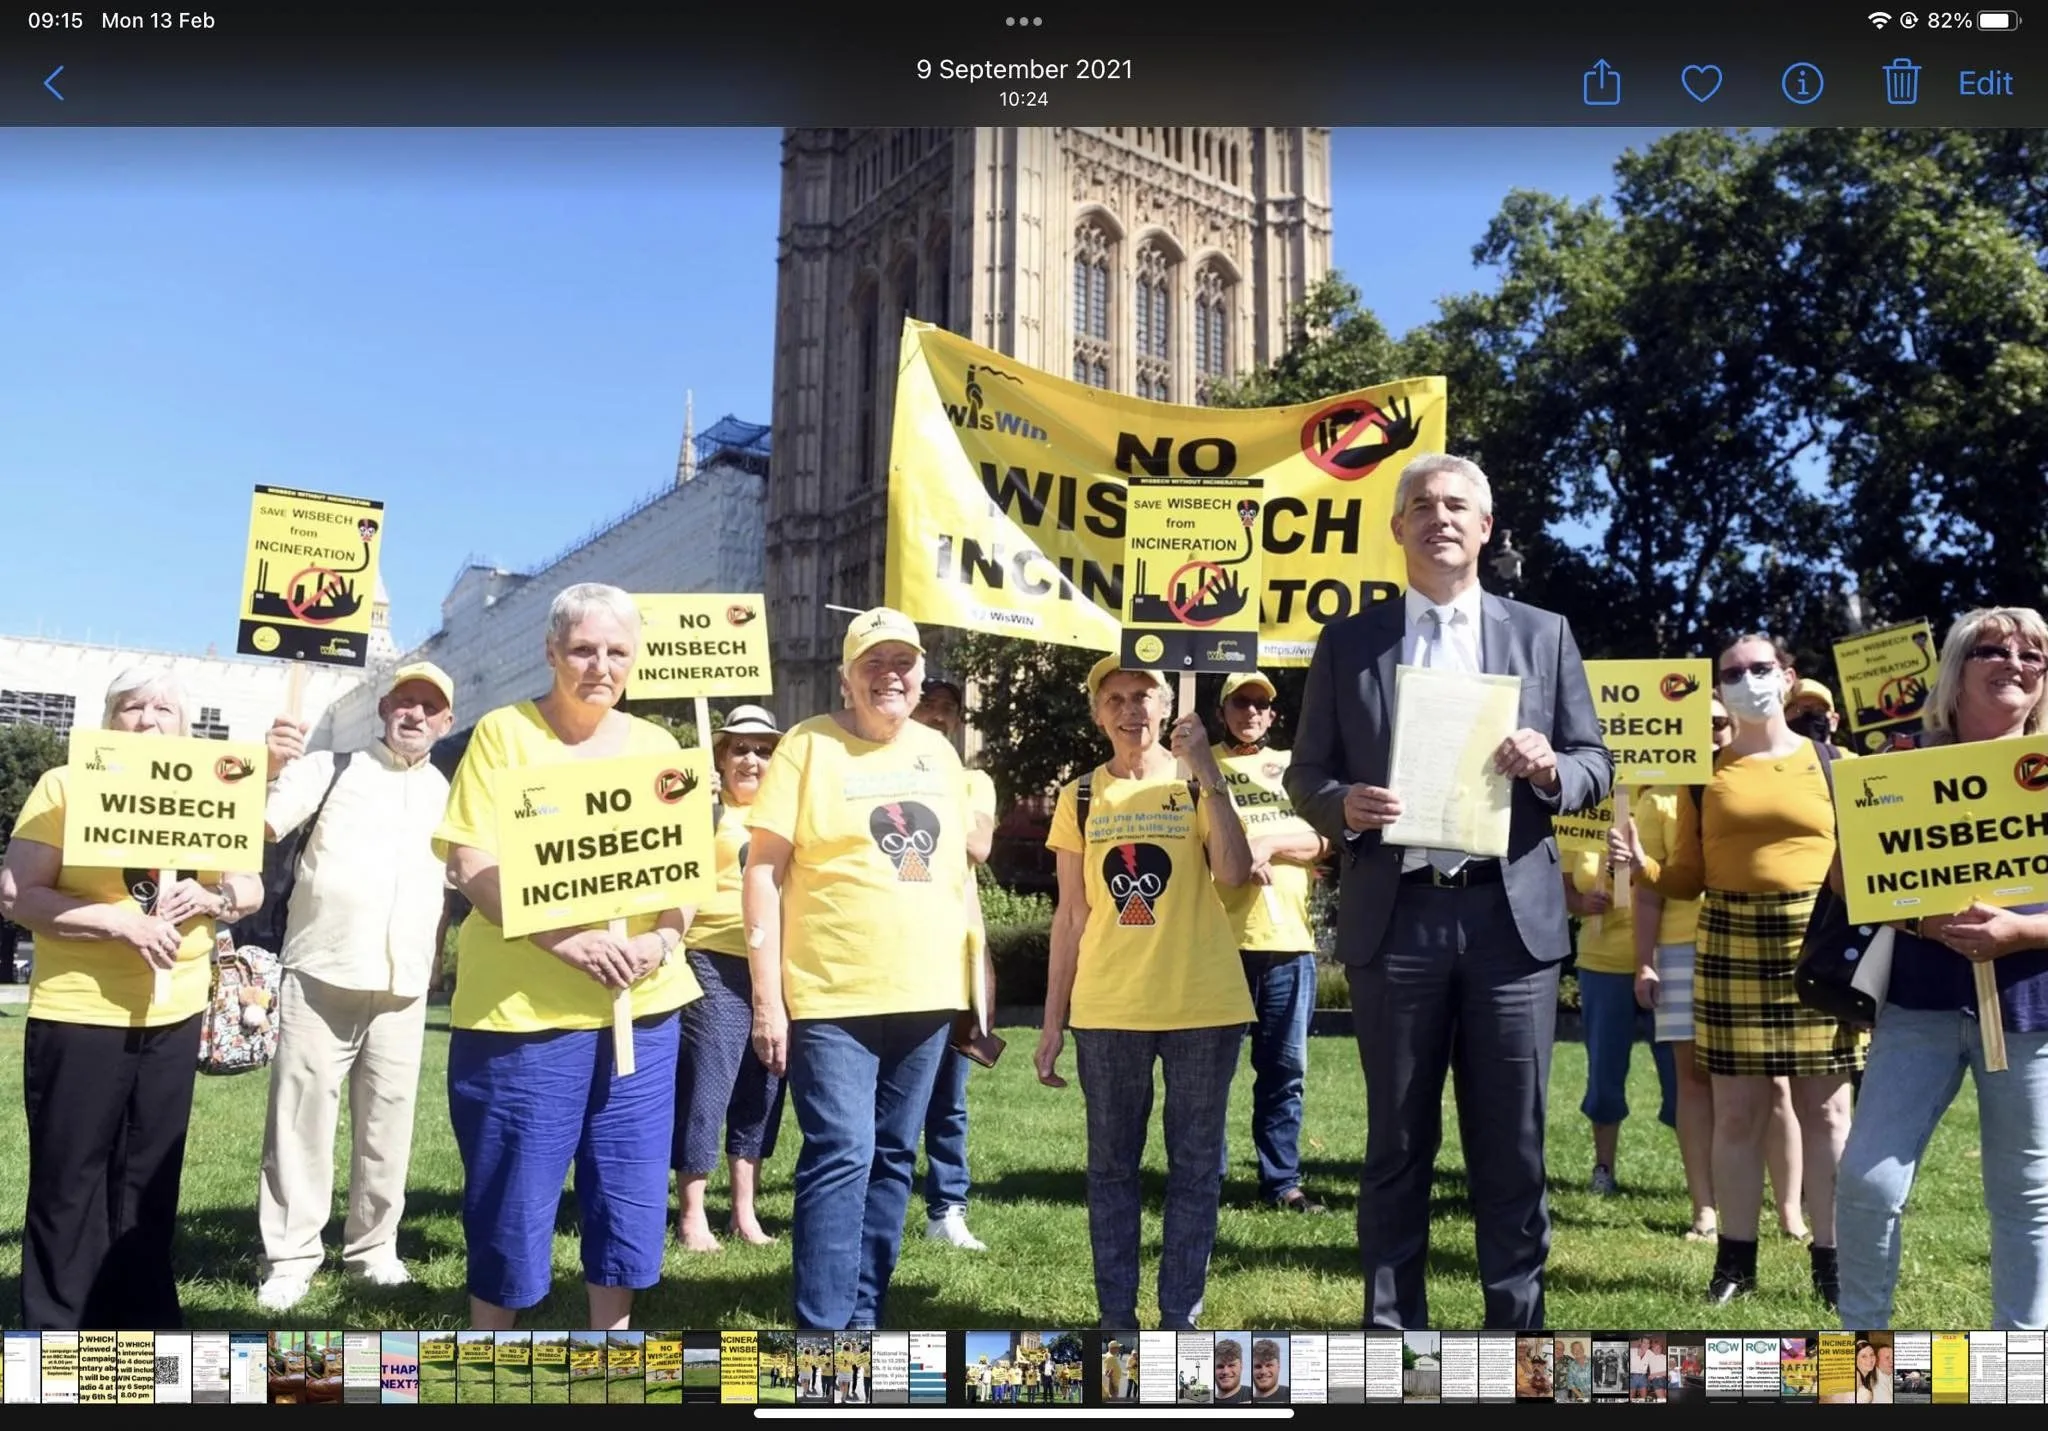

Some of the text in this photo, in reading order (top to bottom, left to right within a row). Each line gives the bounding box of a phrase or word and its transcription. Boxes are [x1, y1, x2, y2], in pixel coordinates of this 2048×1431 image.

[1115, 432, 1237, 478] NO
[980, 462, 1361, 554] WISCH
[1134, 498, 1231, 511] SAVE WISBECH
[260, 506, 353, 525] SAVE WISBECH
[1166, 518, 1195, 529] from
[290, 526, 318, 539] from
[255, 539, 355, 562] INCINERATION
[1131, 537, 1237, 552] INCINERATION
[679, 614, 711, 629] NO
[646, 641, 747, 657] WISBECH
[638, 666, 760, 681] INCINERATOR
[1845, 658, 1920, 682] INCINERATION
[1601, 685, 1640, 703] NO
[1599, 718, 1683, 735] SBECH
[1613, 749, 1697, 764] ERATOR
[151, 761, 193, 782] NO
[1225, 772, 1250, 785] NO
[1855, 790, 1904, 808] WisWin
[1933, 775, 1988, 804] NO
[101, 793, 235, 819] WISBECH
[585, 788, 632, 815] NO
[84, 826, 248, 850] INCINERATOR
[1878, 812, 2048, 855] WISBECH
[534, 823, 683, 866] WISBECH
[522, 860, 701, 906] INCINERATOR
[1866, 854, 2048, 894] INCINERATO
